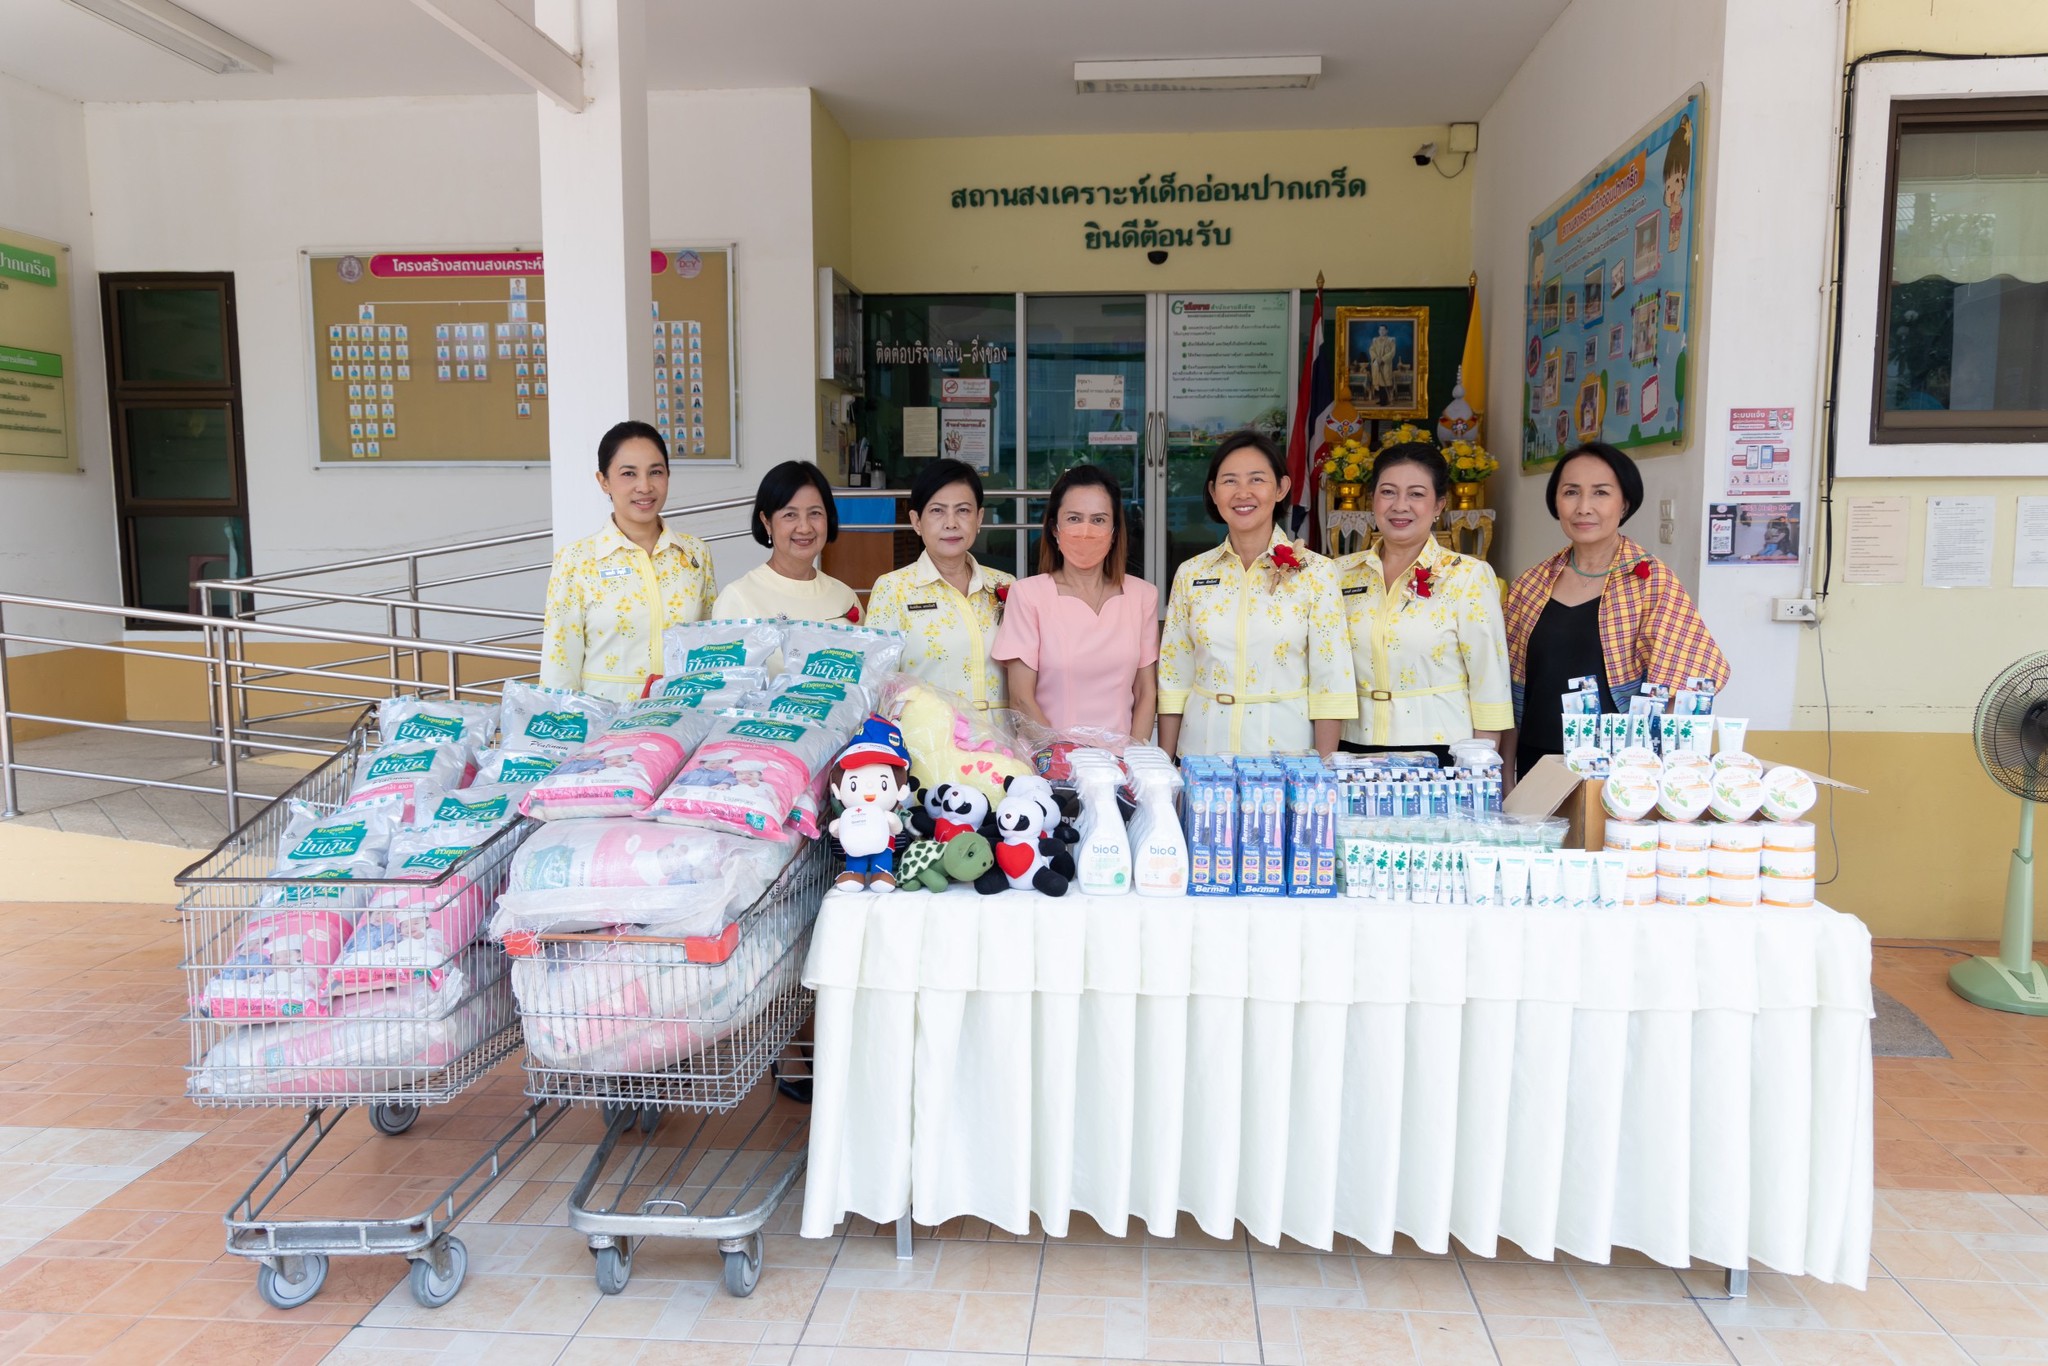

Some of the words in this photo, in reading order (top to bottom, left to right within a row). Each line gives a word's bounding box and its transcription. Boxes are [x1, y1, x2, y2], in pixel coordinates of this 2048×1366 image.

[950, 165, 1367, 209] สถานสงเคราะห์เด็กอ่อนปากเกร็ด
[1084, 219, 1232, 250] ยินดีต้อนรับ
[876, 335, 1008, 364] ติดต่อบริจาคเงิน-สิ่งของ
[806, 660, 855, 681] ปิ่นเงิน
[529, 720, 581, 739] ปิ่นเงิน
[733, 723, 795, 739] ปิ่นเงิน
[372, 758, 425, 773] ปิ่นเงิน
[1192, 813, 1200, 843] Berman
[1241, 814, 1249, 843] Berman
[1293, 815, 1302, 844] Berman
[1315, 815, 1323, 844] Berman
[295, 837, 353, 856] ปิ่นเงิน
[1092, 844, 1119, 855] bioQ
[1149, 845, 1177, 856] bioQ
[1195, 885, 1230, 893] Berman
[1245, 885, 1280, 893] Berman
[1296, 886, 1331, 895] Berman
